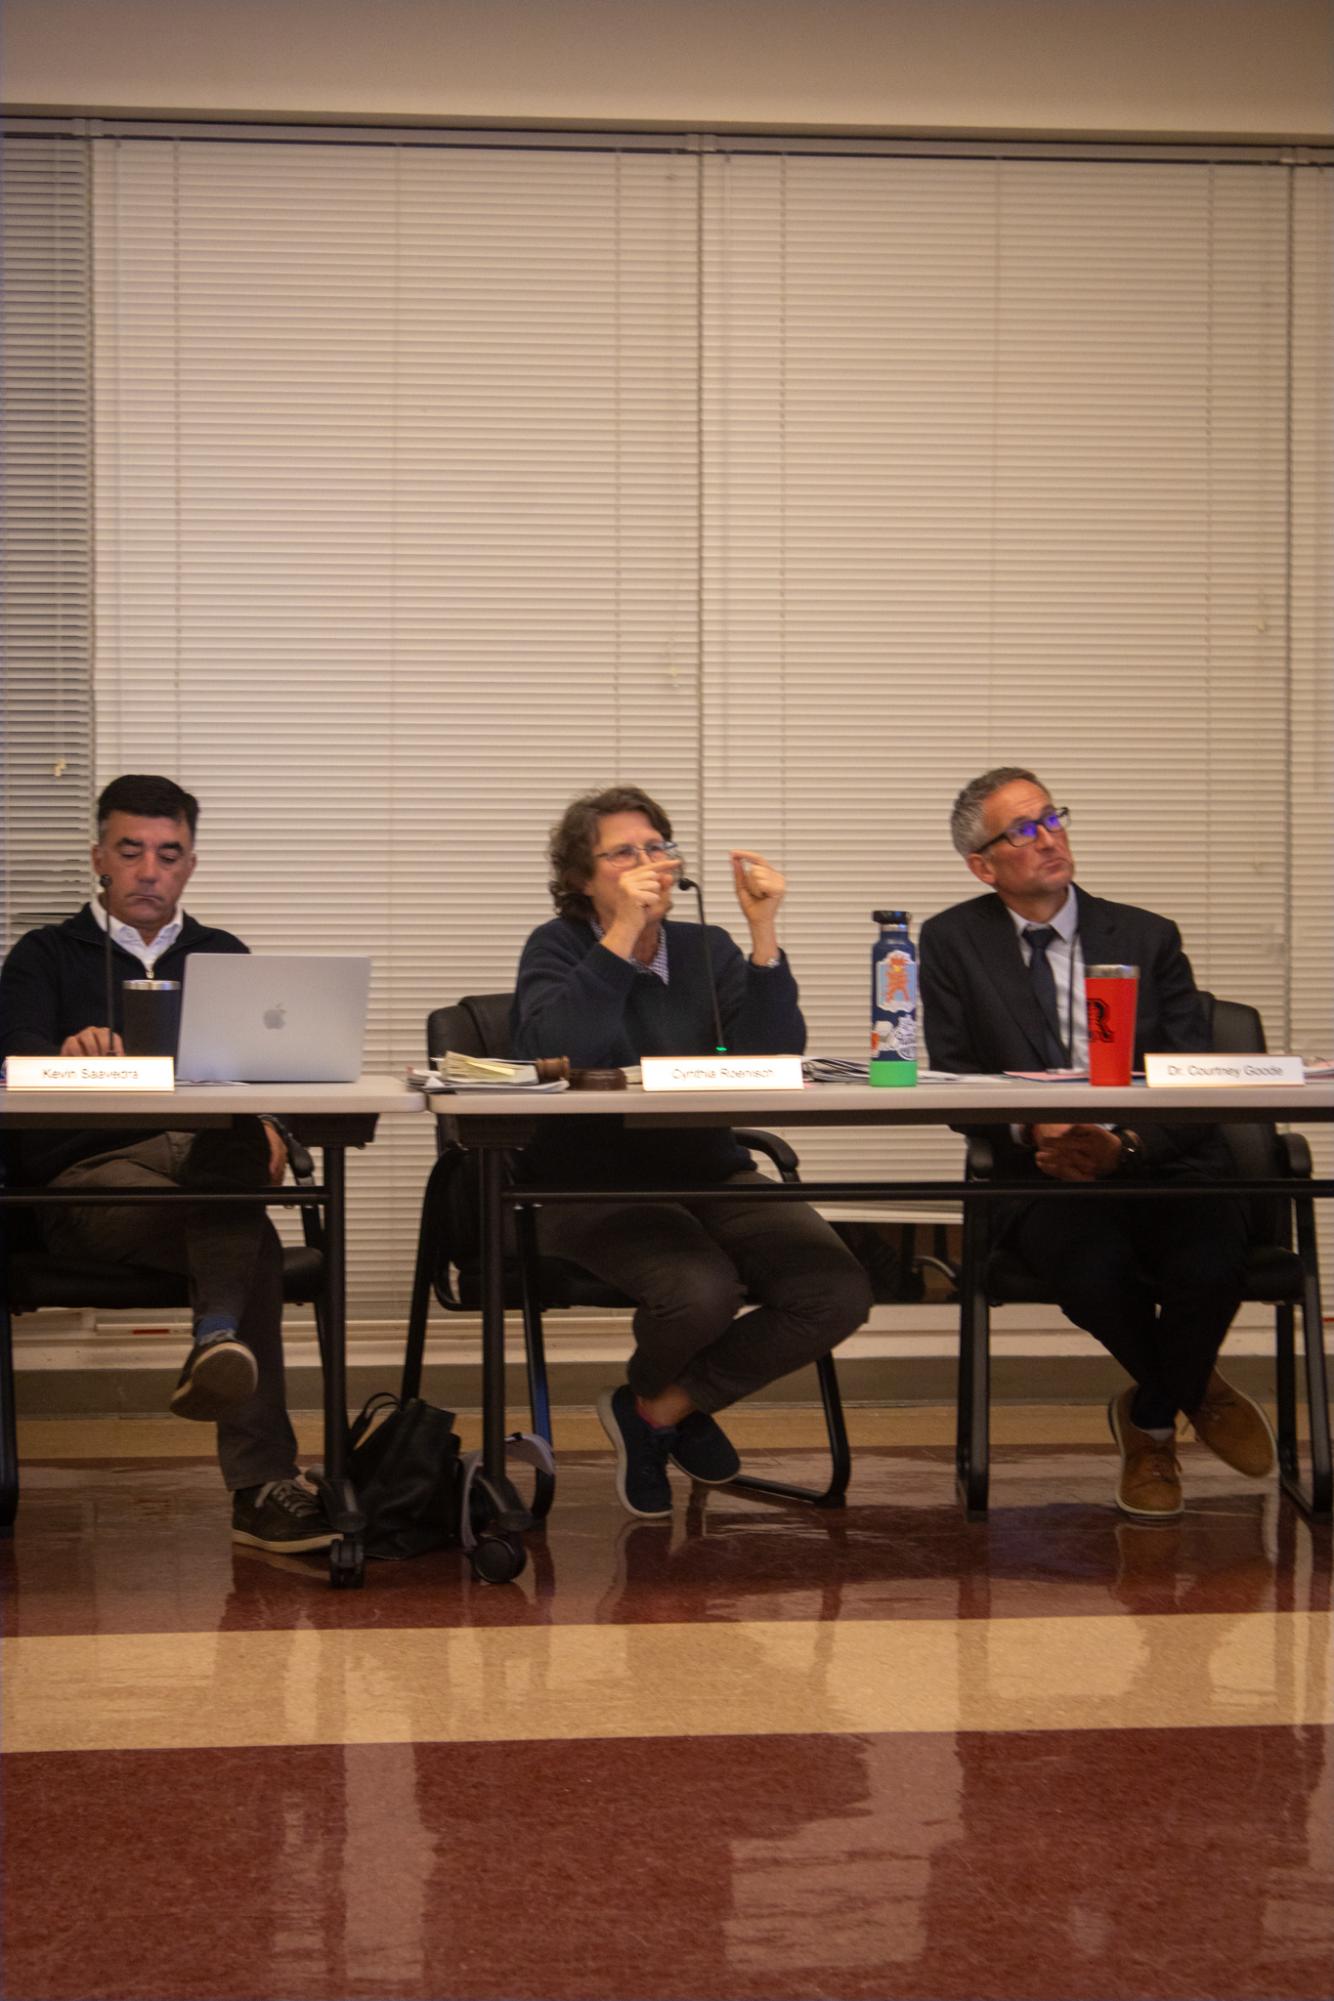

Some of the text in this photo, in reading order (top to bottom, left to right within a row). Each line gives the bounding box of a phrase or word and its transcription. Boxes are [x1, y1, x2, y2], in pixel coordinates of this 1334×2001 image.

[43, 1068, 139, 1079] Kevin Saavedra
[671, 1068, 717, 1081] Cynthia
[1187, 1065, 1240, 1078] Courtney
[1243, 1065, 1284, 1077] Goode
